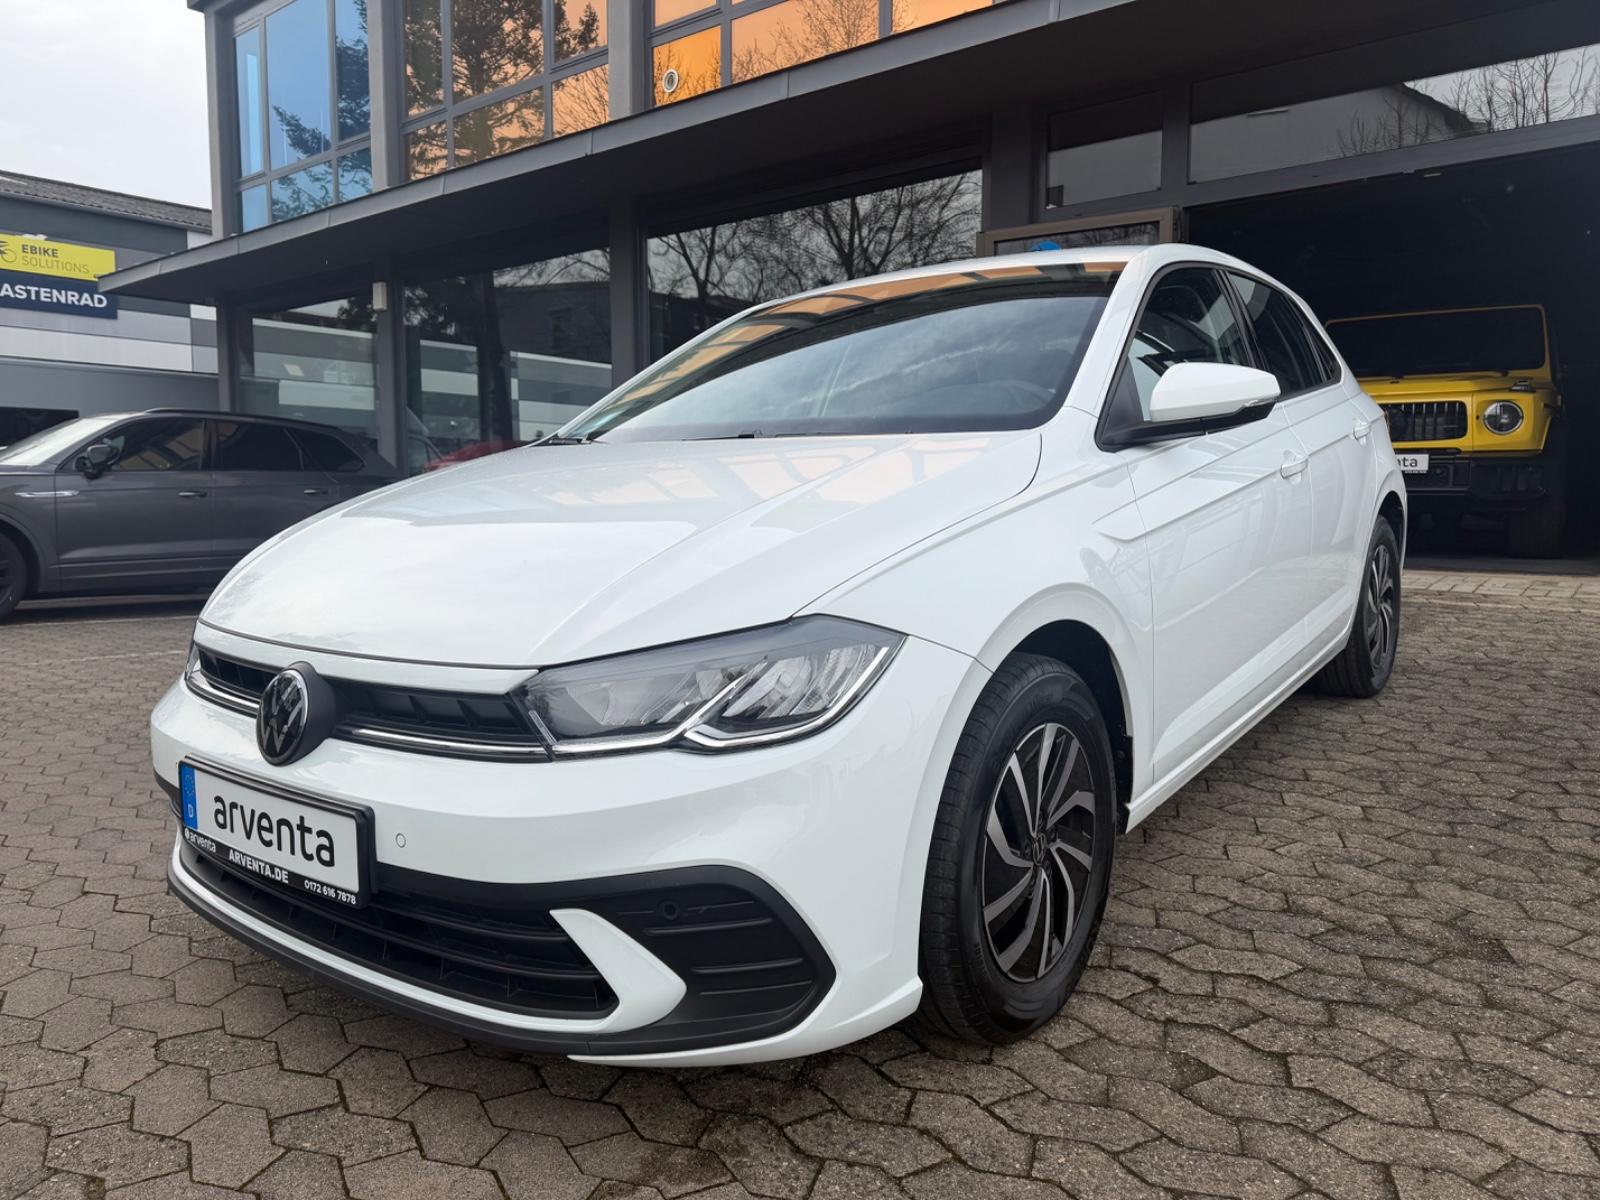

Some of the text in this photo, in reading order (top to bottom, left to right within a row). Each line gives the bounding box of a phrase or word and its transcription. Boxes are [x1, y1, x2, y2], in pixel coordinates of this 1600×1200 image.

[21, 244, 59, 258] EBIKE
[21, 256, 90, 274] SOLUTIONS
[189, 831, 217, 853] arventa
[213, 795, 336, 868] arventa
[228, 849, 289, 884] ARVENTA.DE
[304, 879, 322, 894] 0172
[336, 890, 356, 905] 7878
